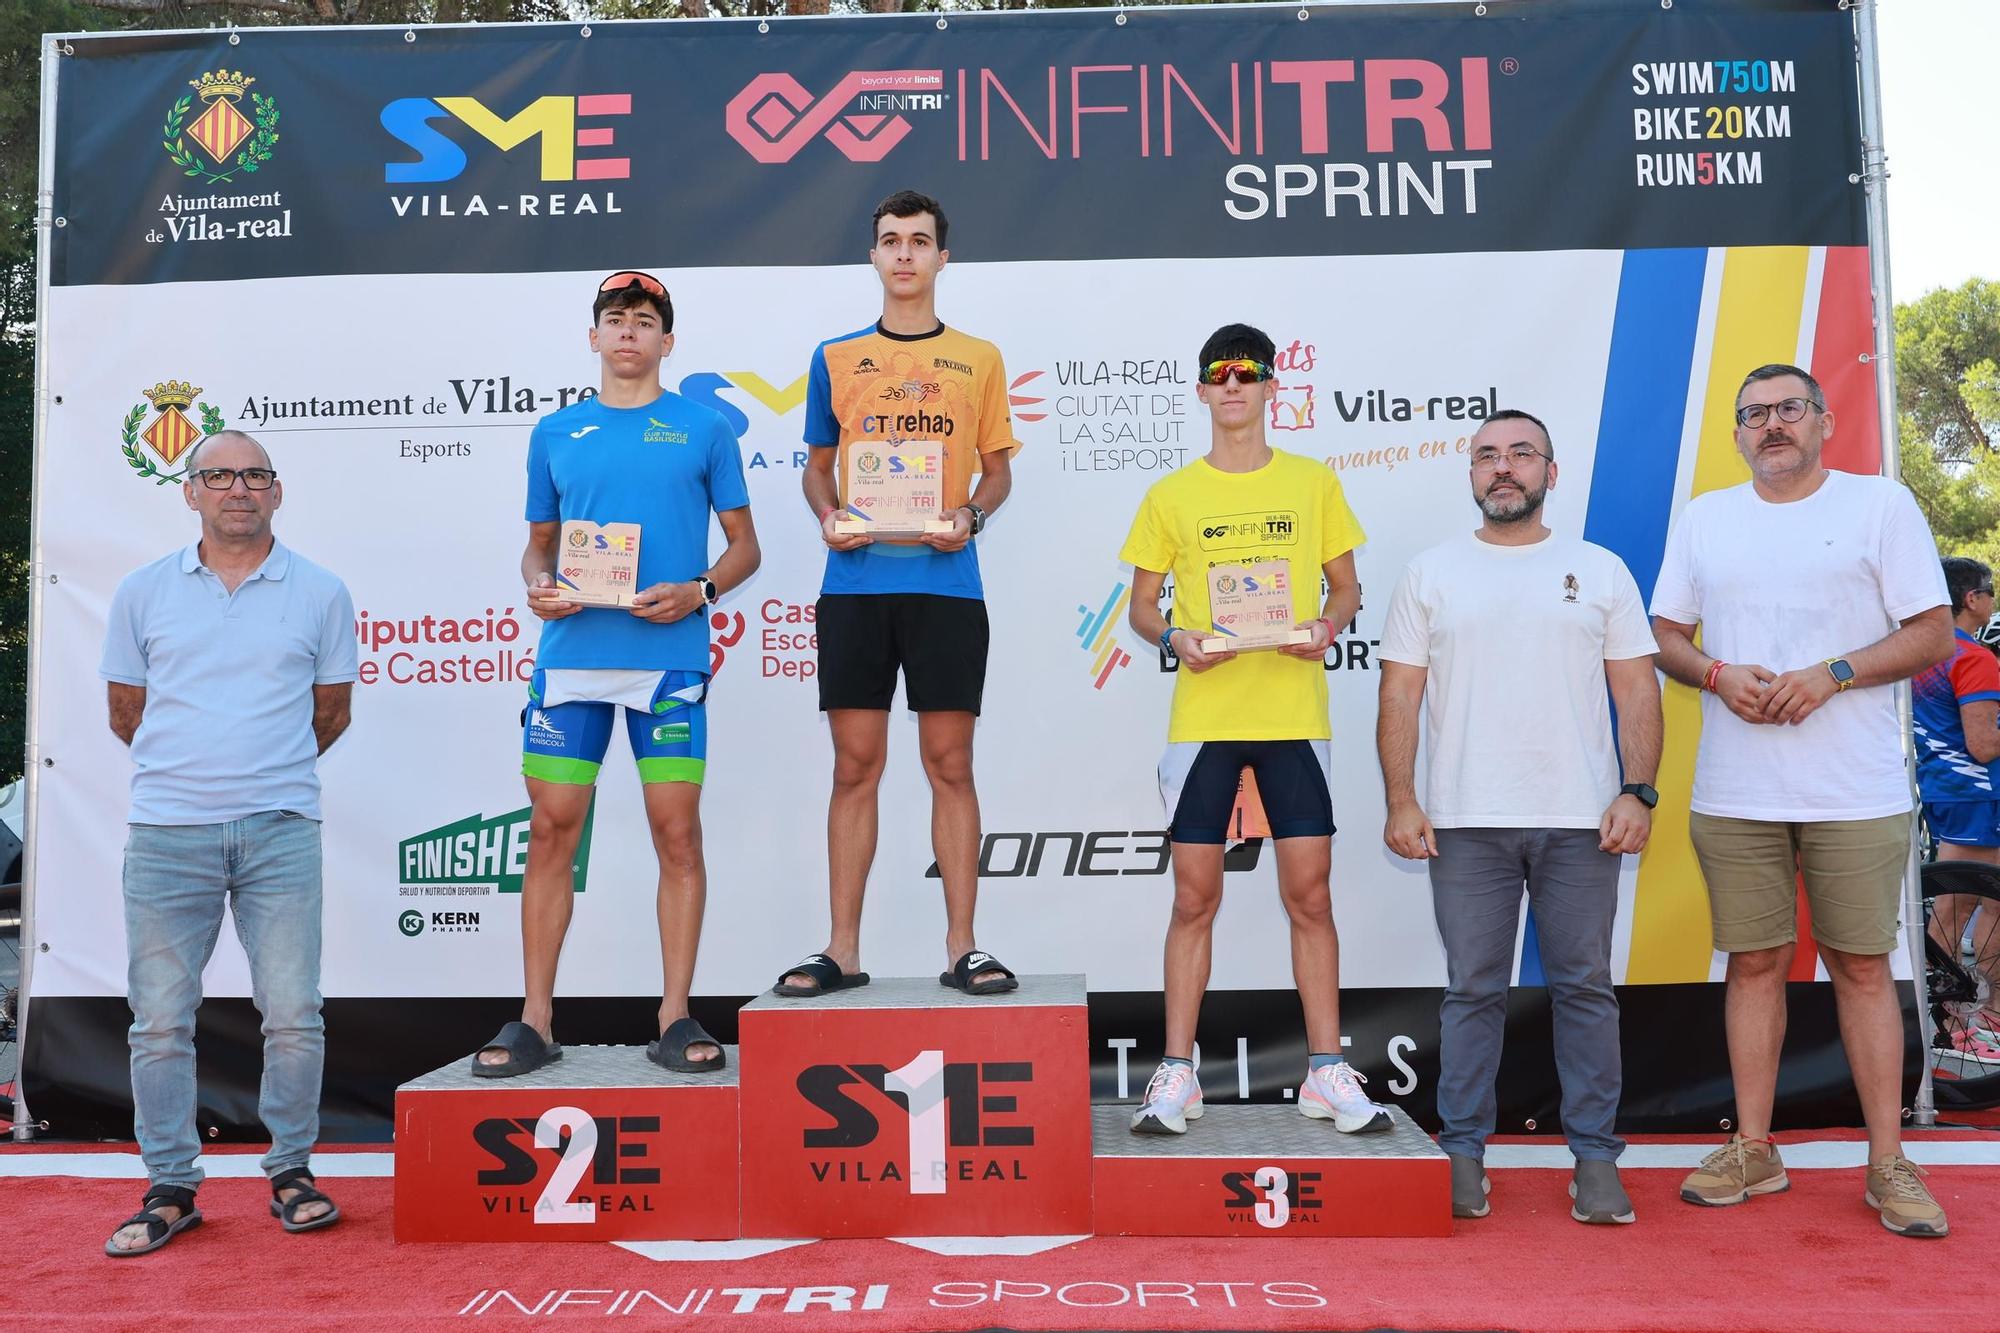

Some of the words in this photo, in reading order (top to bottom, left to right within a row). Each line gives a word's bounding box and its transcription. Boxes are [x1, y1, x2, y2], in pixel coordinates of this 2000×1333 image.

[862, 77, 892, 85] beyond
[894, 76, 912, 85] your
[1632, 60, 1795, 95] SWIM750M
[860, 94, 941, 110] INFINITRI
[958, 57, 1492, 160] INFINITRI
[380, 94, 632, 183] SME
[1636, 152, 1762, 186] RUN5KM
[1224, 160, 1492, 220] SPRINT
[158, 191, 281, 216] Ajuntament
[391, 192, 621, 216] VILA-REAL
[146, 229, 164, 242] de
[164, 210, 292, 242] Vila-real
[1056, 360, 1186, 386] VILA-REAL
[238, 394, 414, 426] Ajuntament
[422, 397, 447, 415] de
[1056, 395, 1144, 416] CIUTAT
[1152, 394, 1185, 415] DE
[1334, 387, 1497, 422] Vila-real
[896, 410, 954, 436] rehab
[1060, 423, 1095, 444] LA
[1102, 422, 1185, 443] SALUT
[400, 439, 471, 462] Esports
[1062, 450, 1066, 471] i
[1075, 448, 1188, 471] L'ESPORT
[1419, 440, 1446, 459] en
[888, 456, 936, 472] SME
[1230, 521, 1292, 536] INFINITRI
[595, 534, 635, 551] SME
[355, 608, 520, 652] iputació
[352, 661, 379, 684] e
[387, 648, 536, 684] Castelló
[925, 830, 1171, 878] ONE3
[399, 887, 417, 896] SALUD
[419, 887, 424, 896] Y
[458, 886, 490, 896] DEPORTIVA
[432, 912, 480, 924] KERN
[884, 1050, 946, 1194] 1
[534, 1106, 598, 1224] 2
[1255, 1166, 1289, 1228] 3
[1228, 1214, 1320, 1223] VILAREAL
[457, 1284, 889, 1315] INFINITRI
[928, 1280, 1328, 1308] SPORTS
